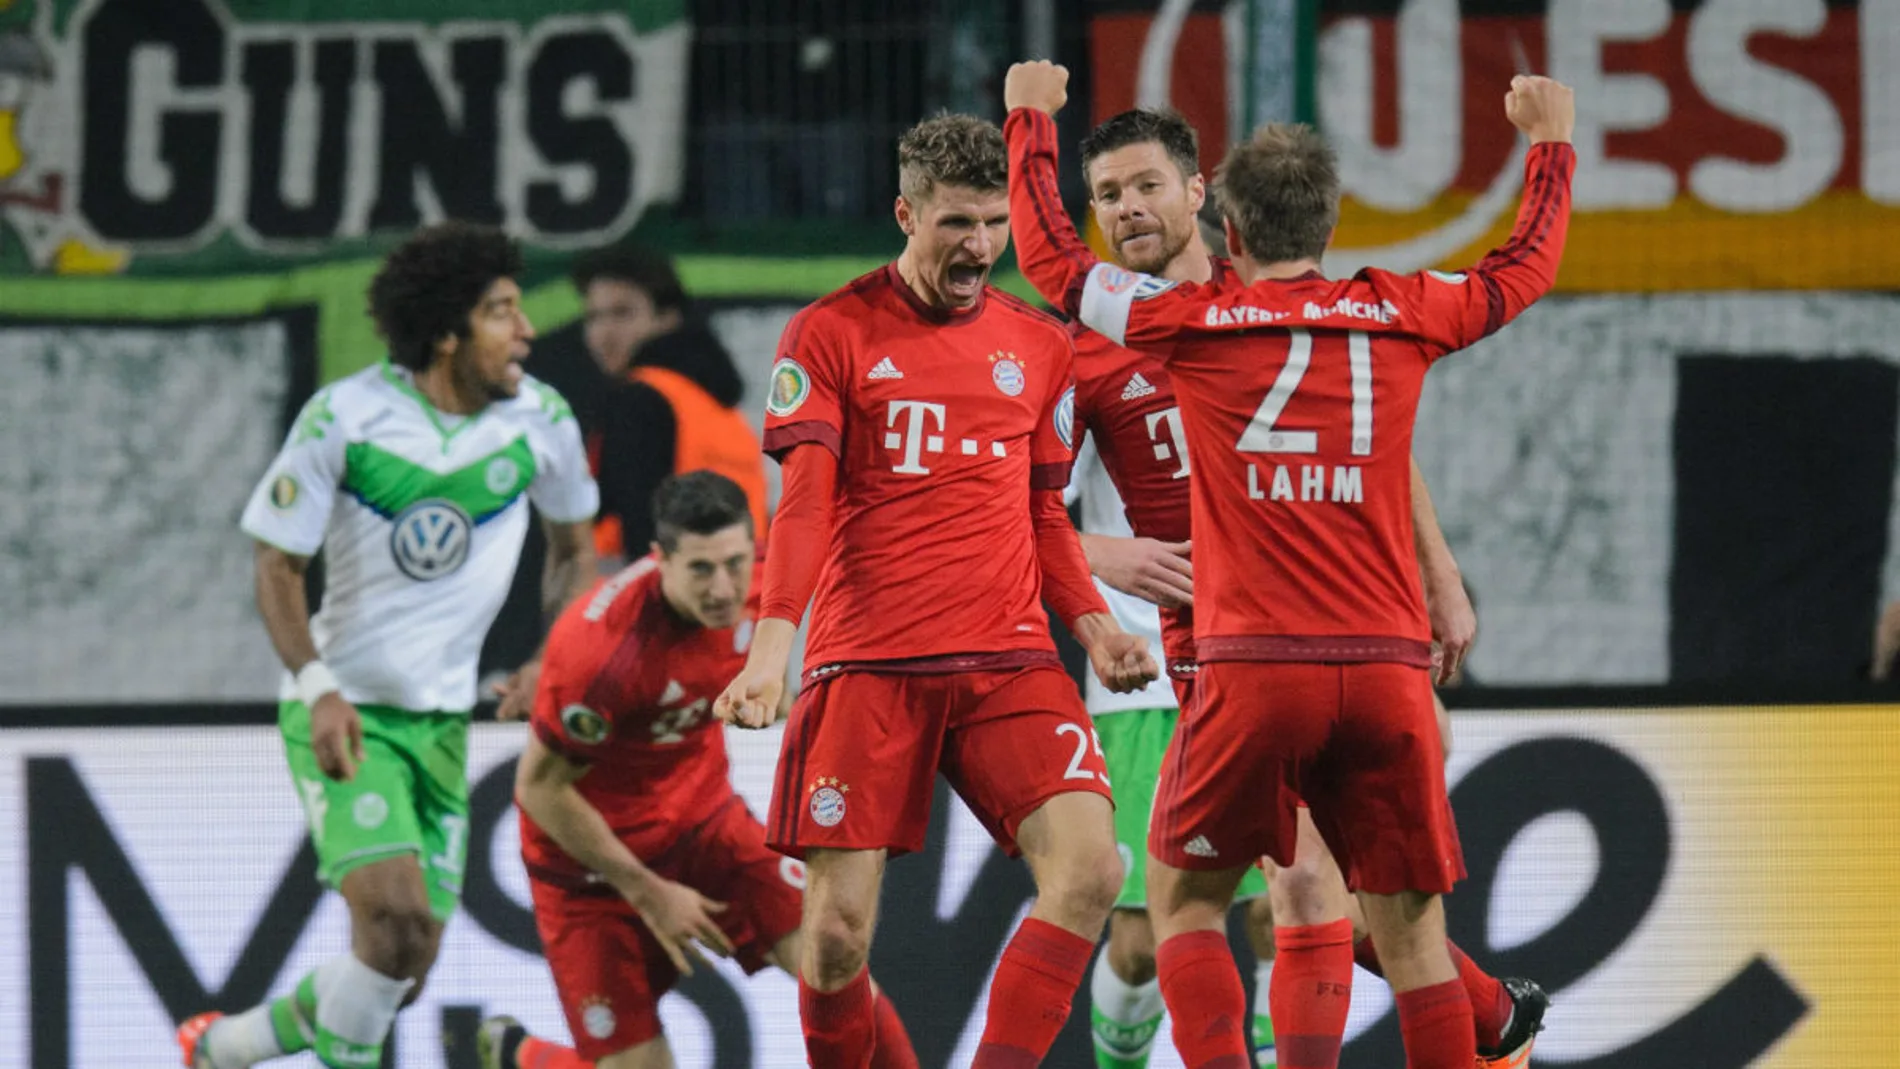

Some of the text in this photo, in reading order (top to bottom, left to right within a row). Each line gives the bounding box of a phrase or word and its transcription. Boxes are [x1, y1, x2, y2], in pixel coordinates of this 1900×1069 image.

[82, 0, 638, 242] GUNS
[1235, 326, 1374, 456] 21
[1247, 463, 1364, 503] LAHM
